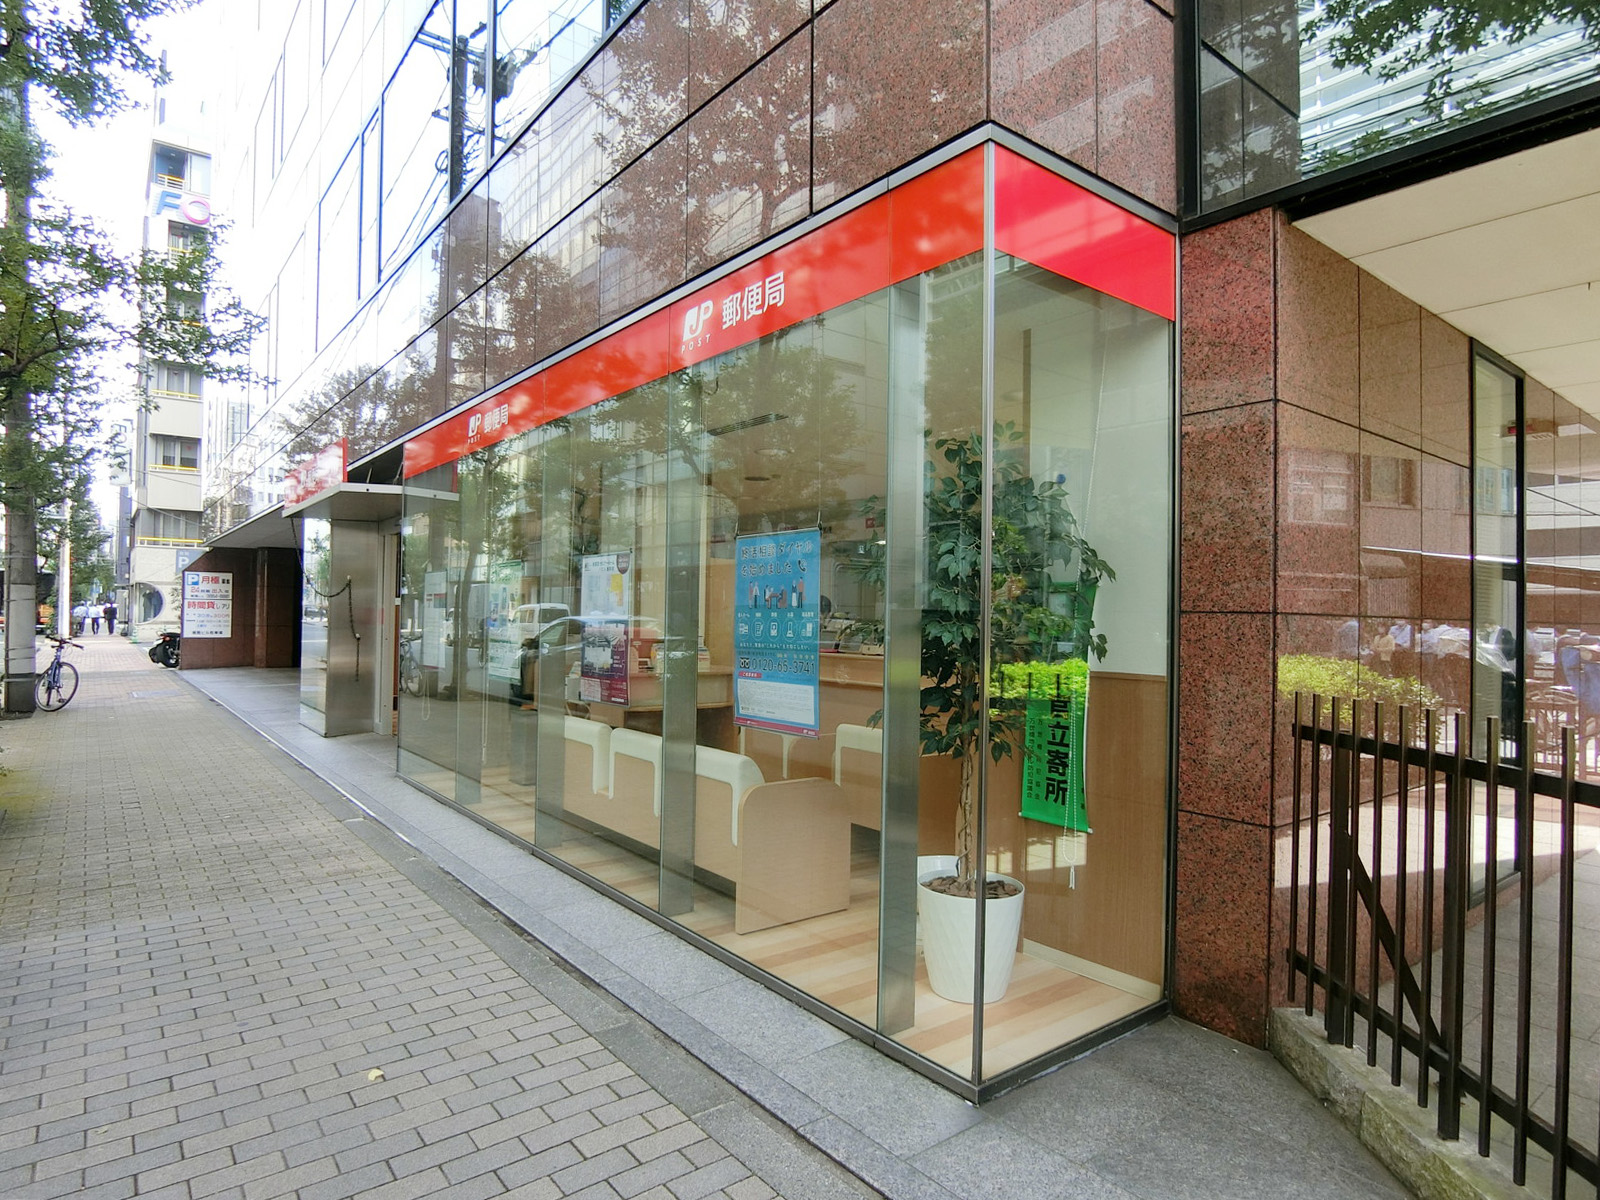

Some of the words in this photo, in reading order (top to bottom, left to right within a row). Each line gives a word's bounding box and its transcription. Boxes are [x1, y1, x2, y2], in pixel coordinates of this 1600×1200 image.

[722, 271, 785, 330] 郵便局
[681, 334, 711, 354] POST
[484, 404, 509, 434] 郵便局
[178, 556, 190, 568] P
[187, 574, 199, 585] P
[751, 658, 816, 675] 0120-65-3741
